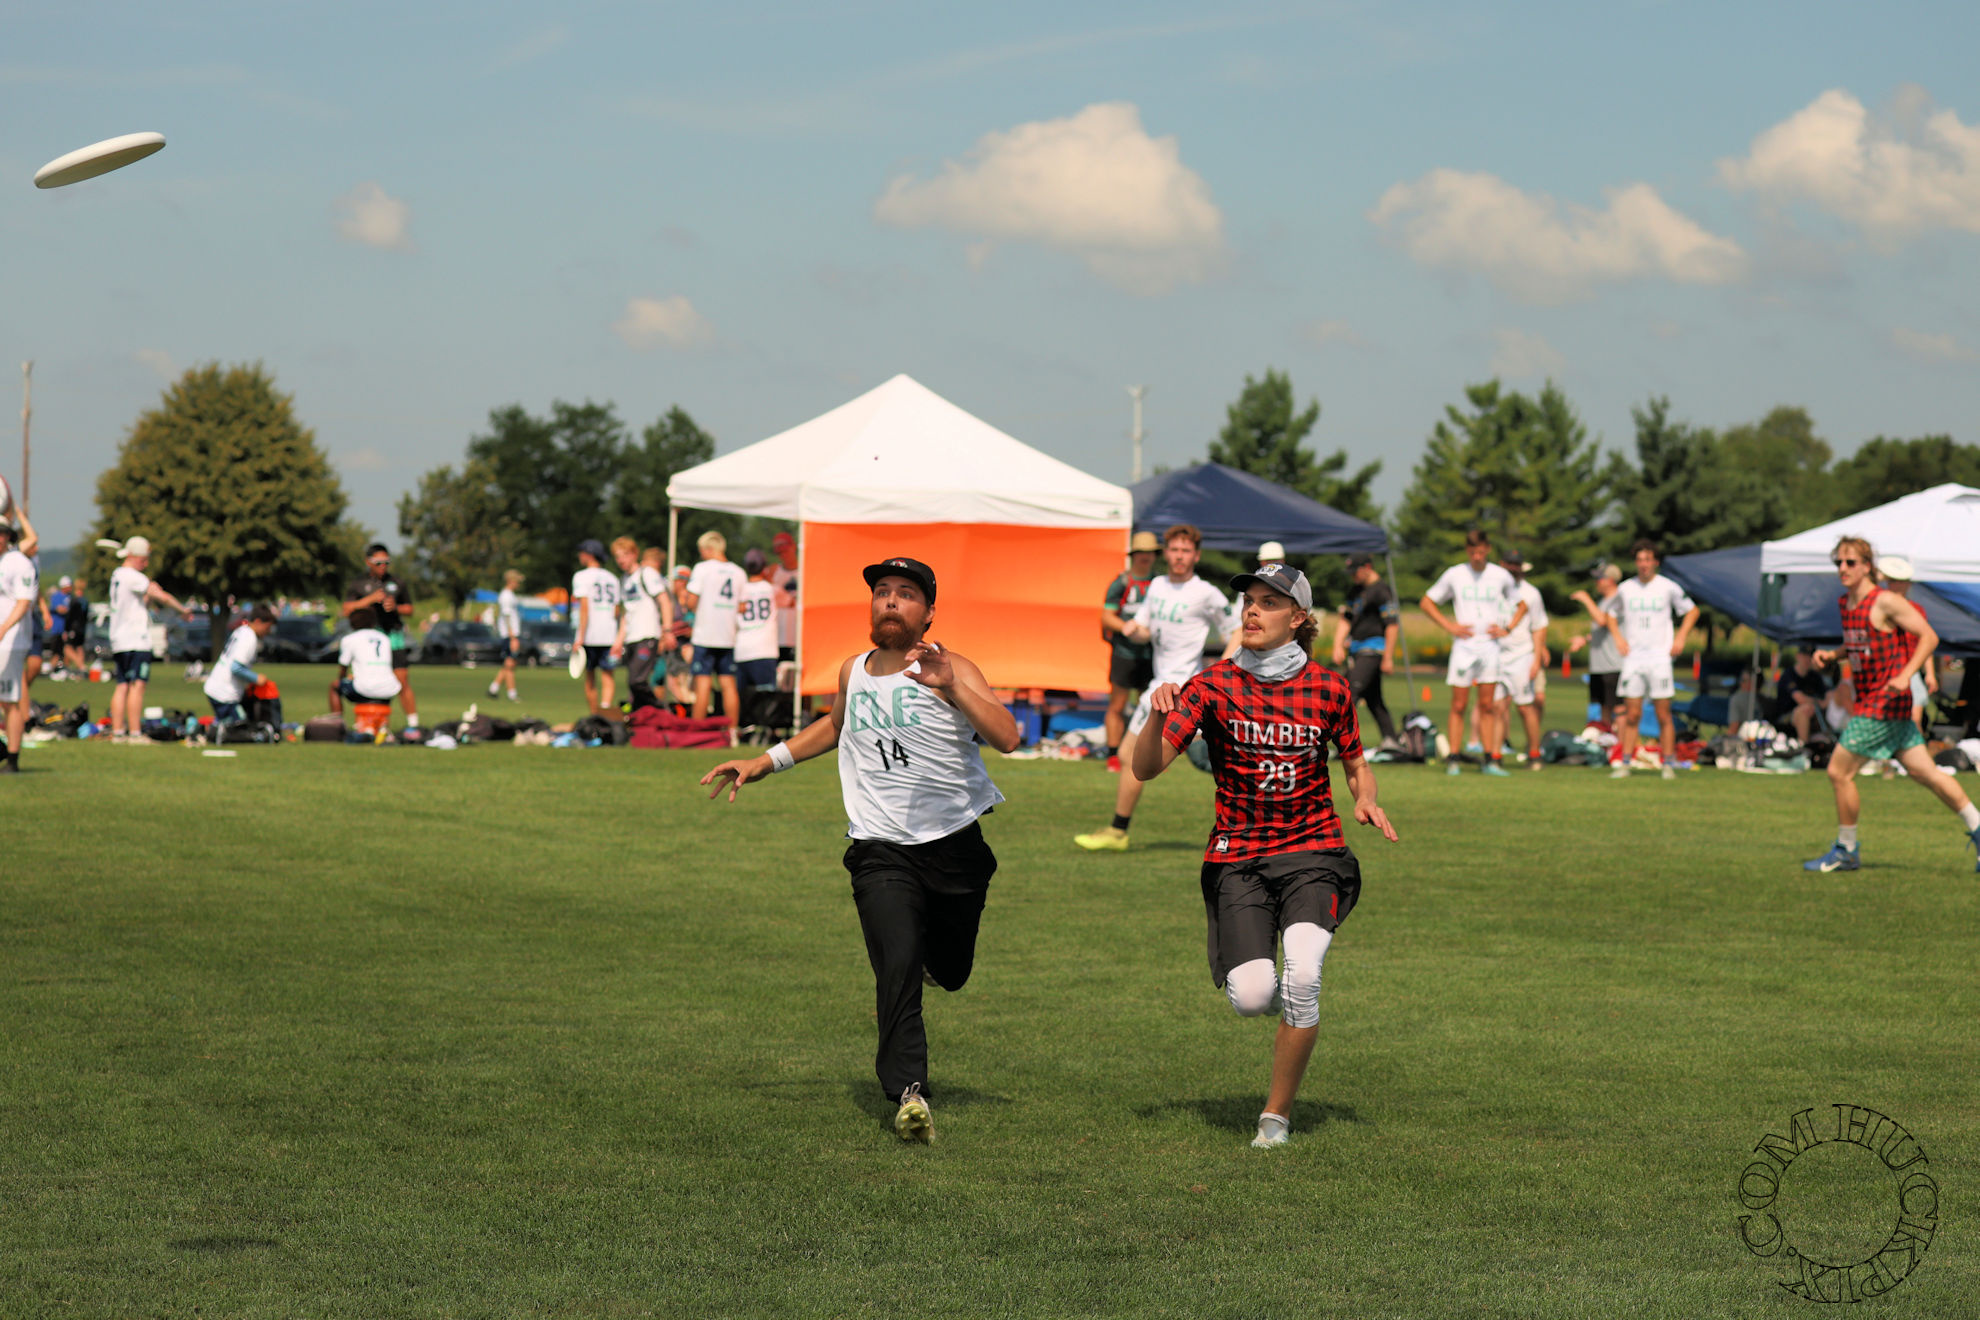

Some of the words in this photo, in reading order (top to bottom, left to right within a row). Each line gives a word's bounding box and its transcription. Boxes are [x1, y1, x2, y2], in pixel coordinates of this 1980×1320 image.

[594, 582, 615, 603] 35
[720, 578, 732, 600] 4
[742, 598, 771, 621] 88
[369, 638, 381, 657] 7
[1229, 719, 1321, 747] TIMBER
[875, 739, 909, 771] 14
[1258, 759, 1297, 793] 29
